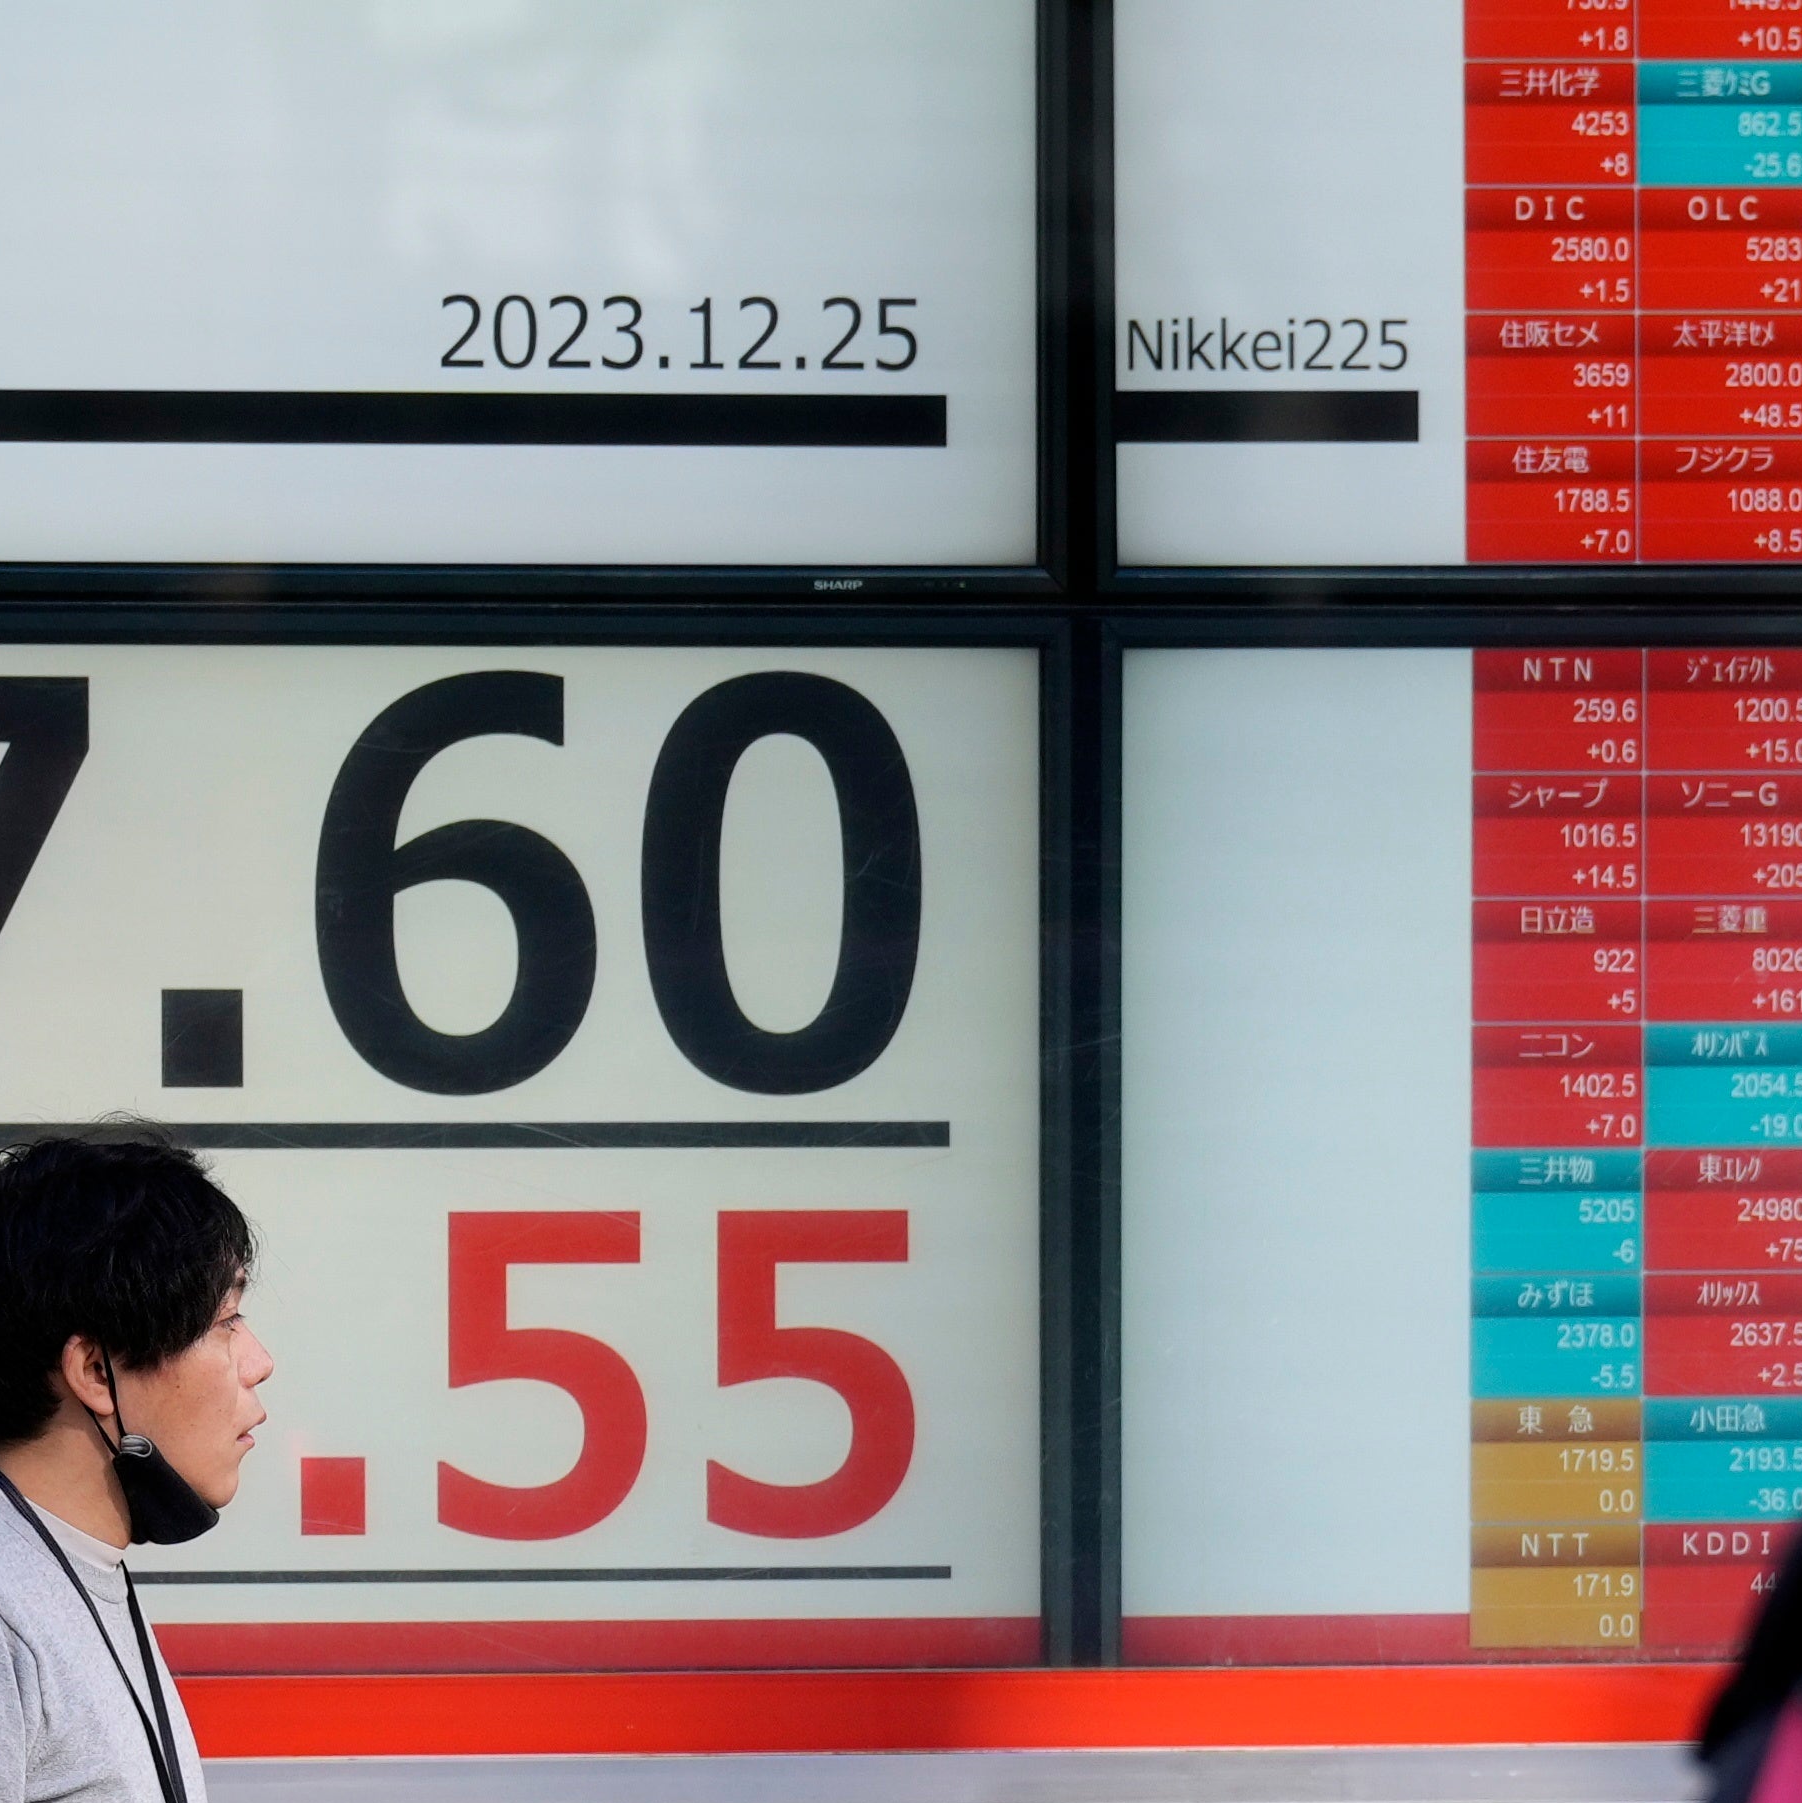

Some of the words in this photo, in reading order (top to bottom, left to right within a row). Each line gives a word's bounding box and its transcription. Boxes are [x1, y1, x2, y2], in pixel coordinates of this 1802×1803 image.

[1738, 27, 1802, 54] +10.5
[1499, 66, 1601, 97] 三井化学
[1571, 110, 1631, 136] 4253
[1738, 111, 1802, 137] 862.5
[1551, 236, 1631, 262] 2580.0
[1579, 277, 1631, 303] +1.5
[440, 294, 918, 372] 2023.12.25
[1127, 317, 1408, 372] Nikkei225
[1499, 320, 1600, 349] 住阪セメ
[1573, 362, 1632, 388] 3659
[1511, 445, 1590, 474] 住友電
[1676, 446, 1775, 473] フジクラ
[1554, 487, 1631, 513] 1788.5
[813, 579, 863, 591] SHARP
[1573, 697, 1638, 723] 259.6
[1508, 777, 1609, 809] シャープ
[1681, 781, 1779, 808] ソニーG
[1560, 822, 1637, 848] 1016.5
[1572, 863, 1637, 889] +14.5
[1520, 905, 1595, 934] 日立造
[1519, 1033, 1595, 1059] ニコン
[1560, 1073, 1637, 1098] 1402.5
[1519, 1155, 1595, 1185] 三井物
[1517, 1279, 1594, 1308] みずほ
[1689, 1402, 1767, 1433] 小田急
[1573, 1572, 1636, 1597] 171.9
